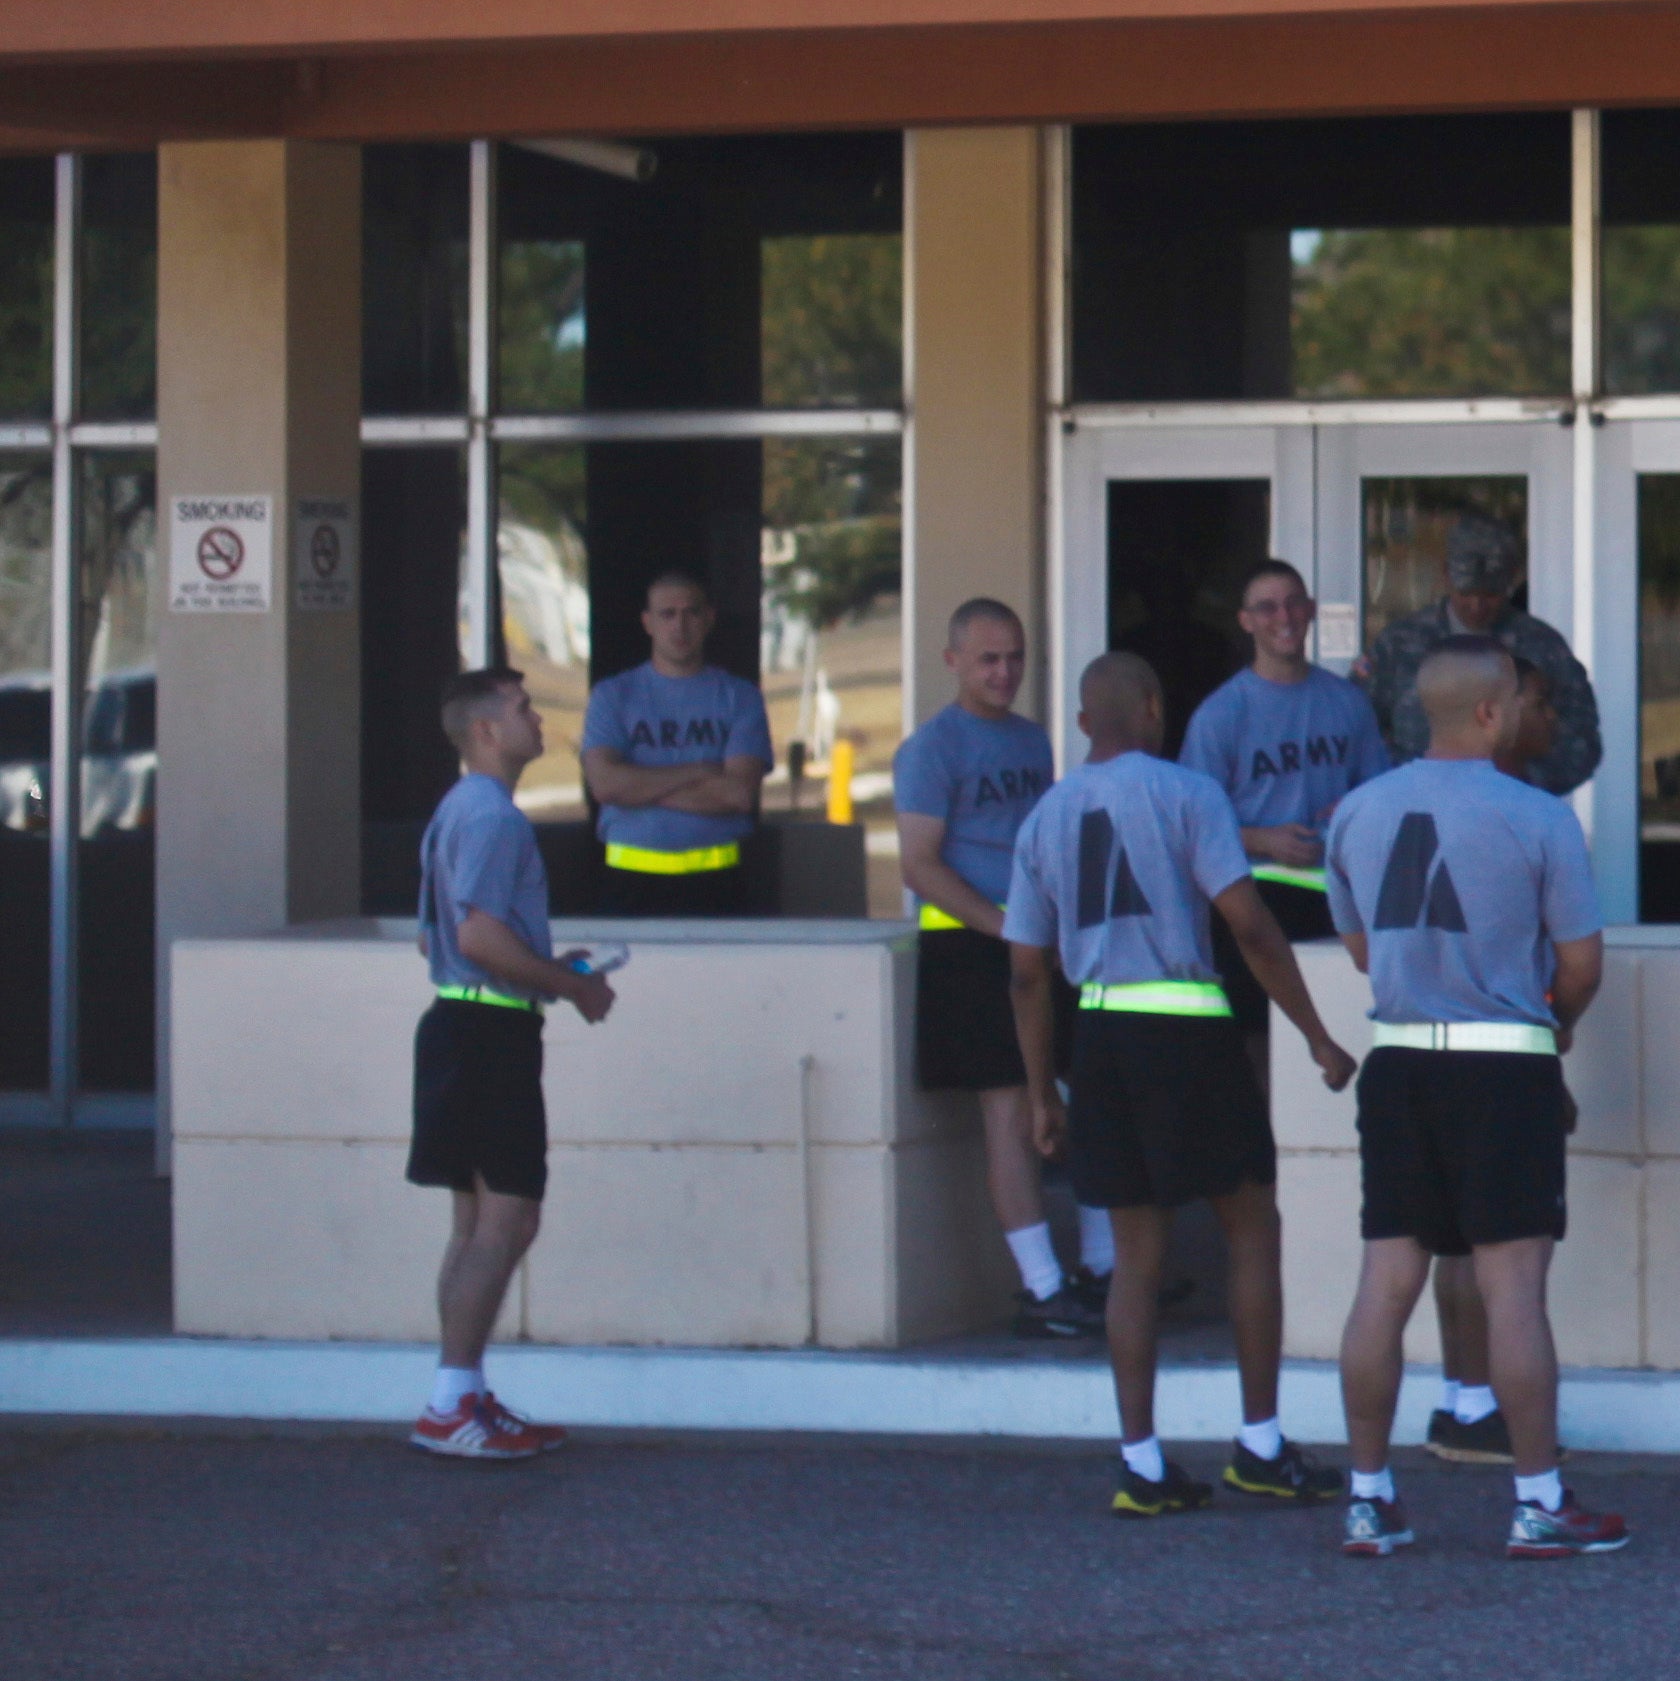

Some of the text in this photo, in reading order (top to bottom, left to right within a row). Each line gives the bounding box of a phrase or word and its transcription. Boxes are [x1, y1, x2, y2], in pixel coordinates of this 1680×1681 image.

[177, 501, 266, 522] SMOKING
[630, 718, 733, 750] ARMY
[1251, 734, 1350, 780] ARMY
